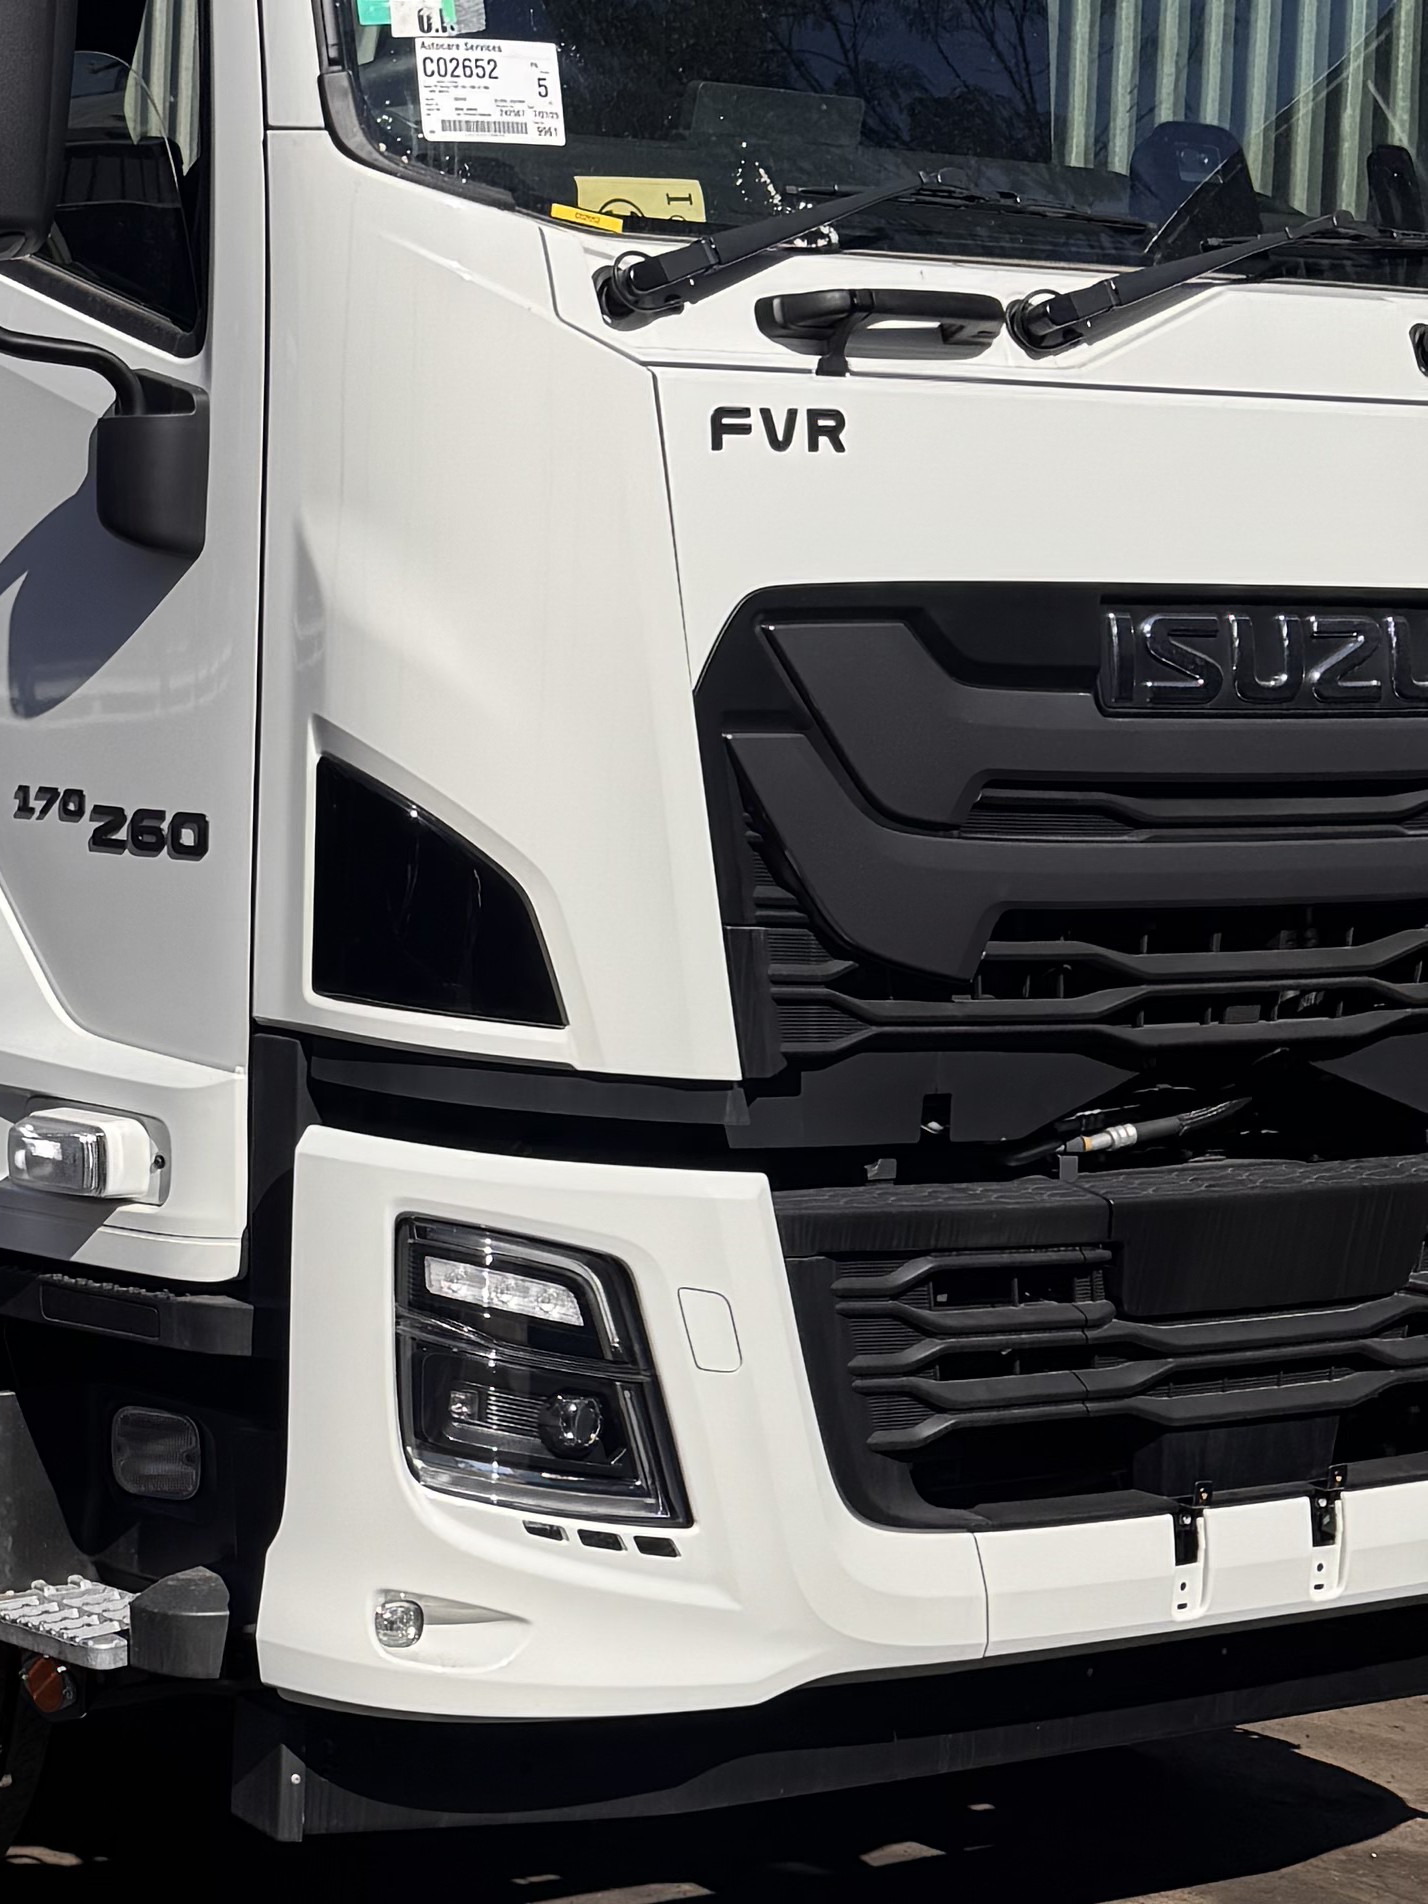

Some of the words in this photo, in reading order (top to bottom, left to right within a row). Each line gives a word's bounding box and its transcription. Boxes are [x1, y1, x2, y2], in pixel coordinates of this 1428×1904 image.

[464, 42, 503, 53] Services
[422, 56, 499, 80] C02652
[537, 77, 549, 98] 5
[710, 406, 846, 454] FVR
[13, 784, 86, 824] 170
[88, 804, 210, 862] 260
